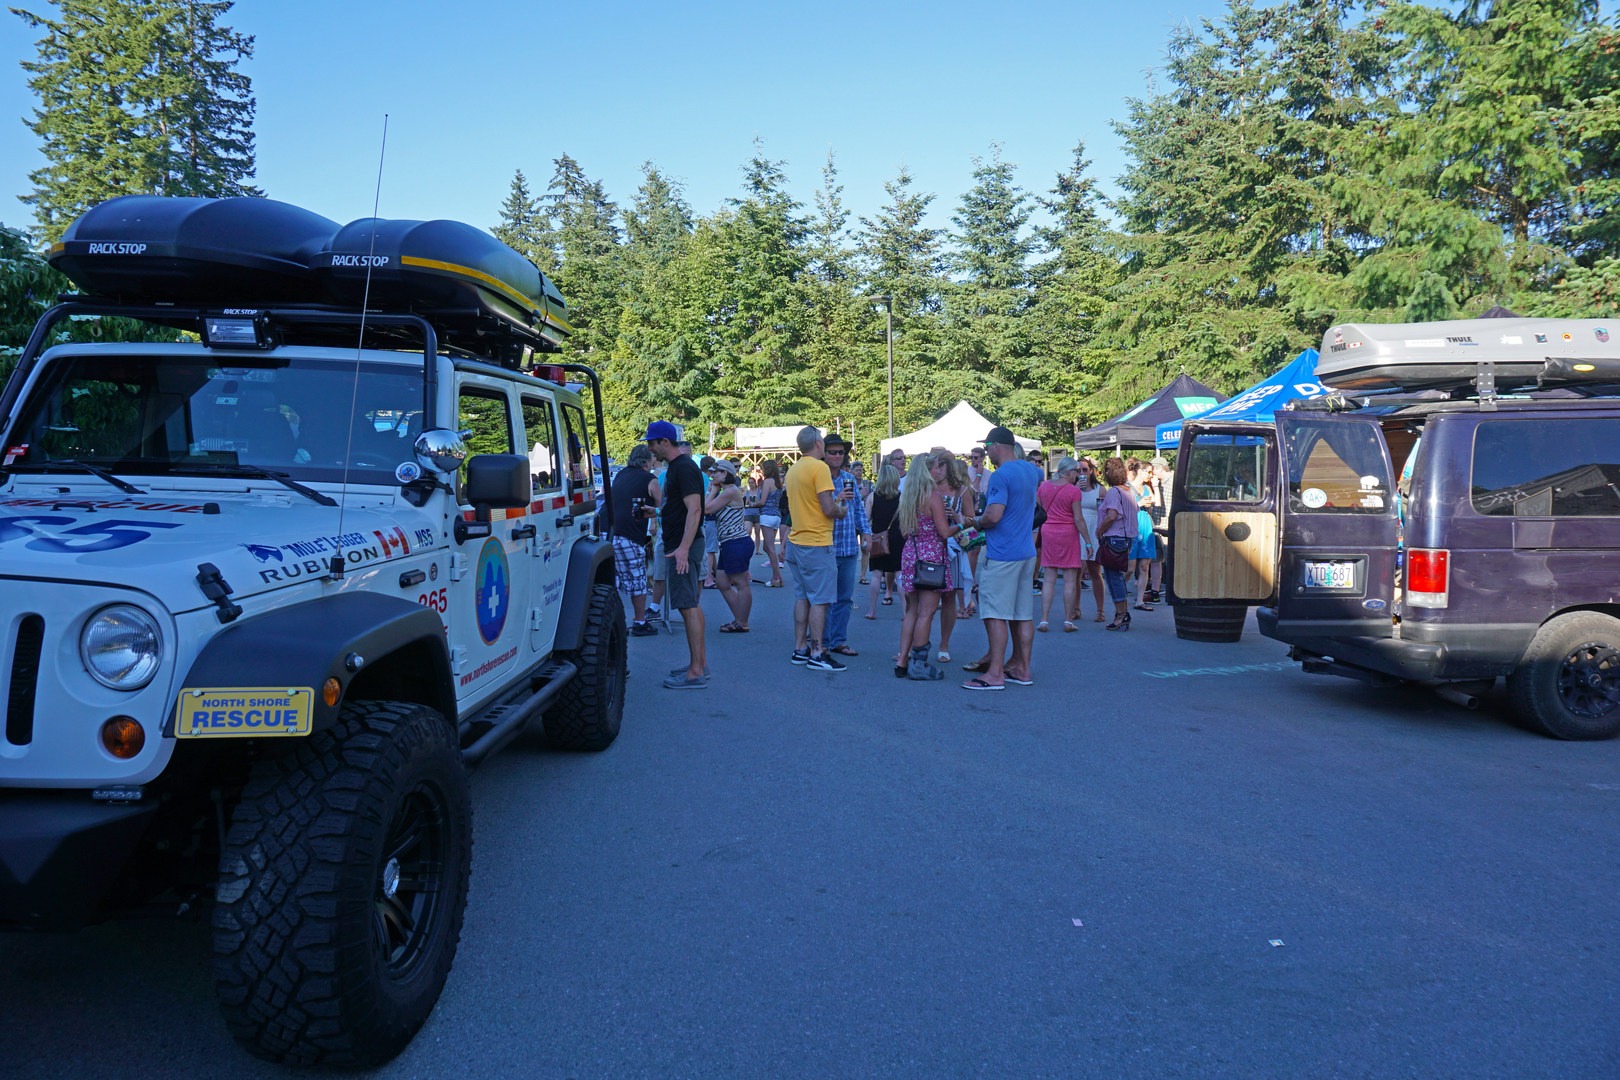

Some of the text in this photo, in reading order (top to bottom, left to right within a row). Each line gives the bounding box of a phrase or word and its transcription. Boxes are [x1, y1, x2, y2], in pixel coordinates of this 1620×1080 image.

[88, 243, 147, 255] RACK STOP
[331, 255, 389, 267] RACK STOP
[1330, 342, 1347, 353] THULE
[322, 532, 368, 550] LEGGER
[414, 528, 434, 548] NS5
[258, 546, 379, 584] RUBION
[1307, 566, 1351, 582] XTD 687
[202, 698, 291, 708] NORTH SHORE
[192, 709, 298, 728] RESCUE
